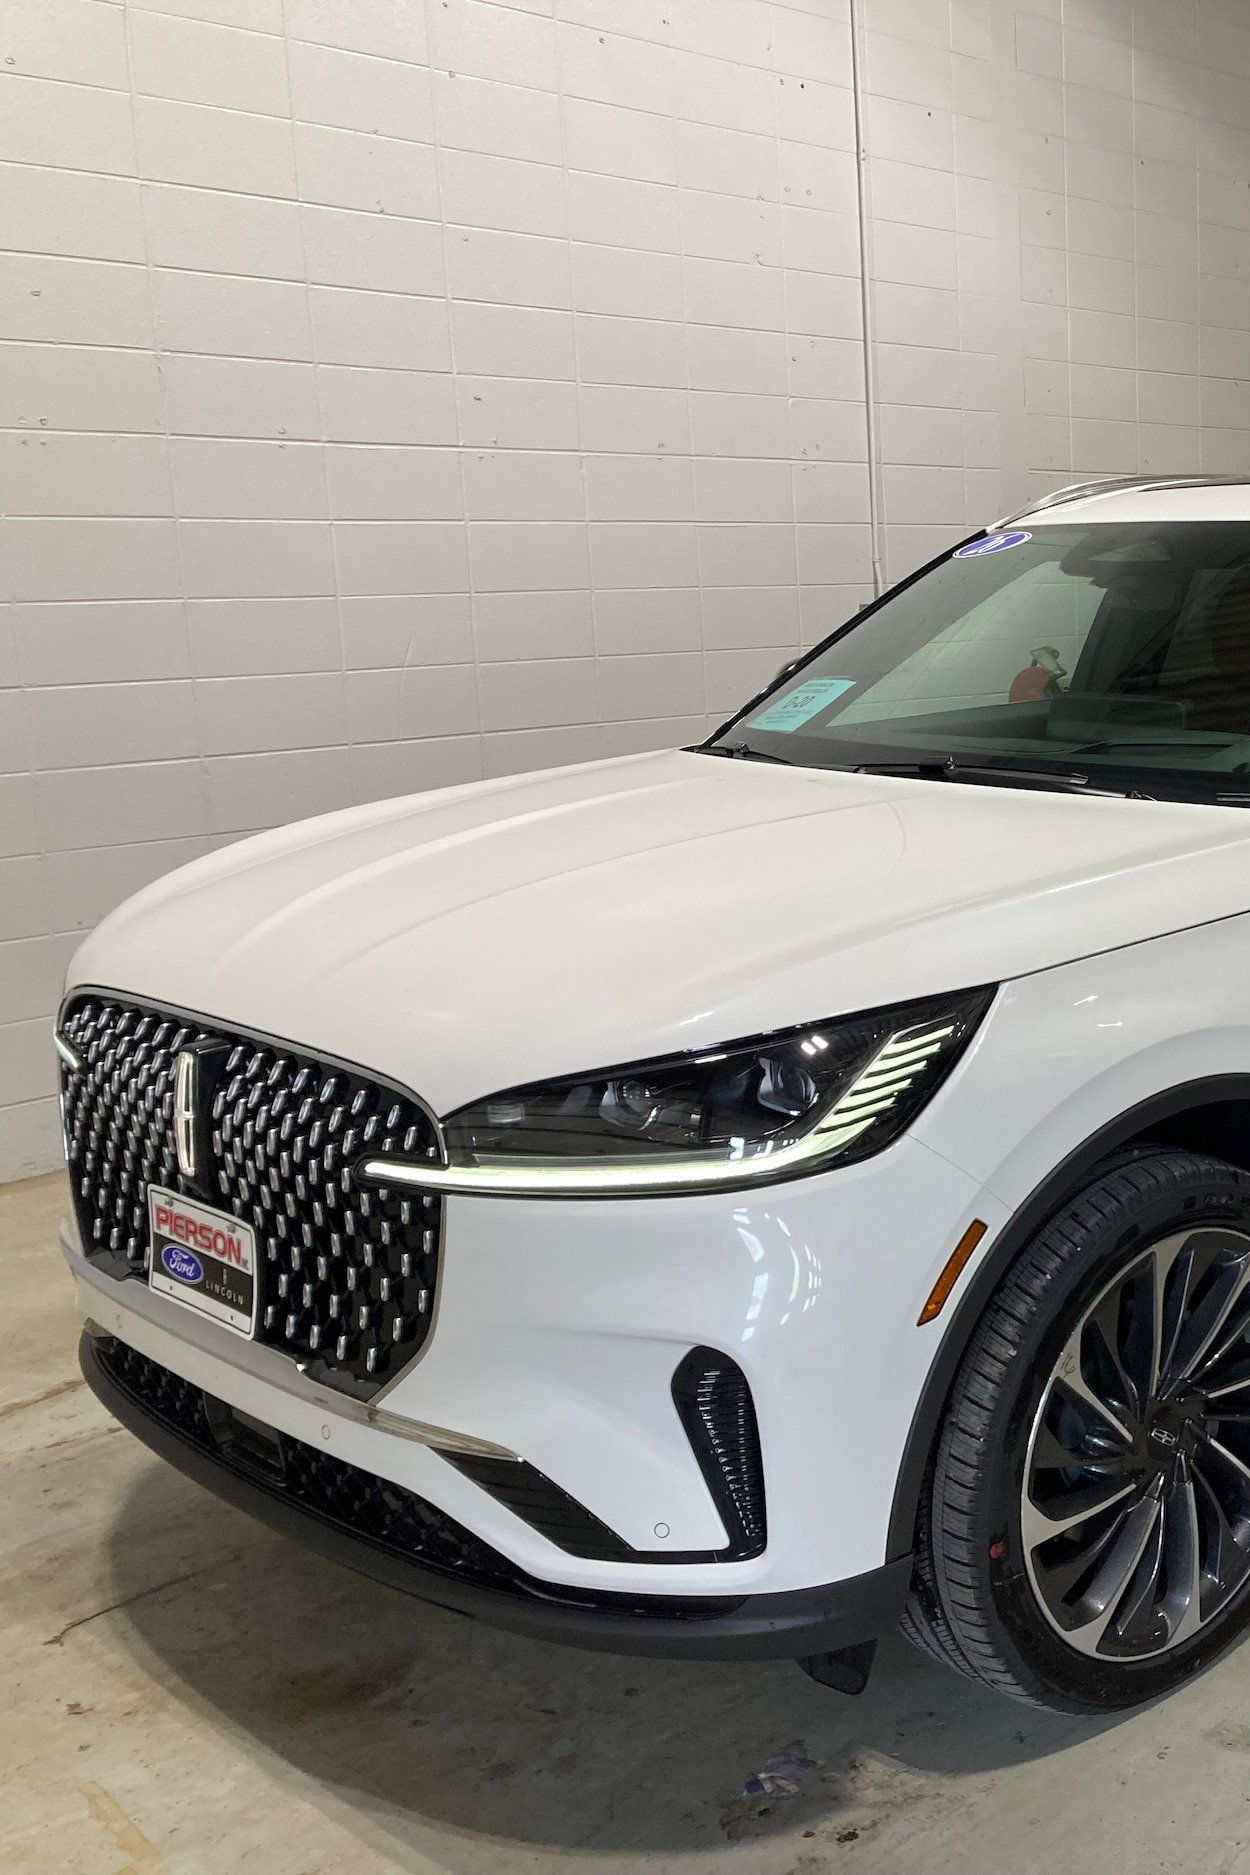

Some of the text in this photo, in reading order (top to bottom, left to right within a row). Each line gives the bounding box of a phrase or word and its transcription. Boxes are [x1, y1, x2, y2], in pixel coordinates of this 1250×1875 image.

[154, 1204, 242, 1266] PIERSON
[168, 1249, 196, 1278] Ford
[205, 1281, 244, 1306] LINCOLN
